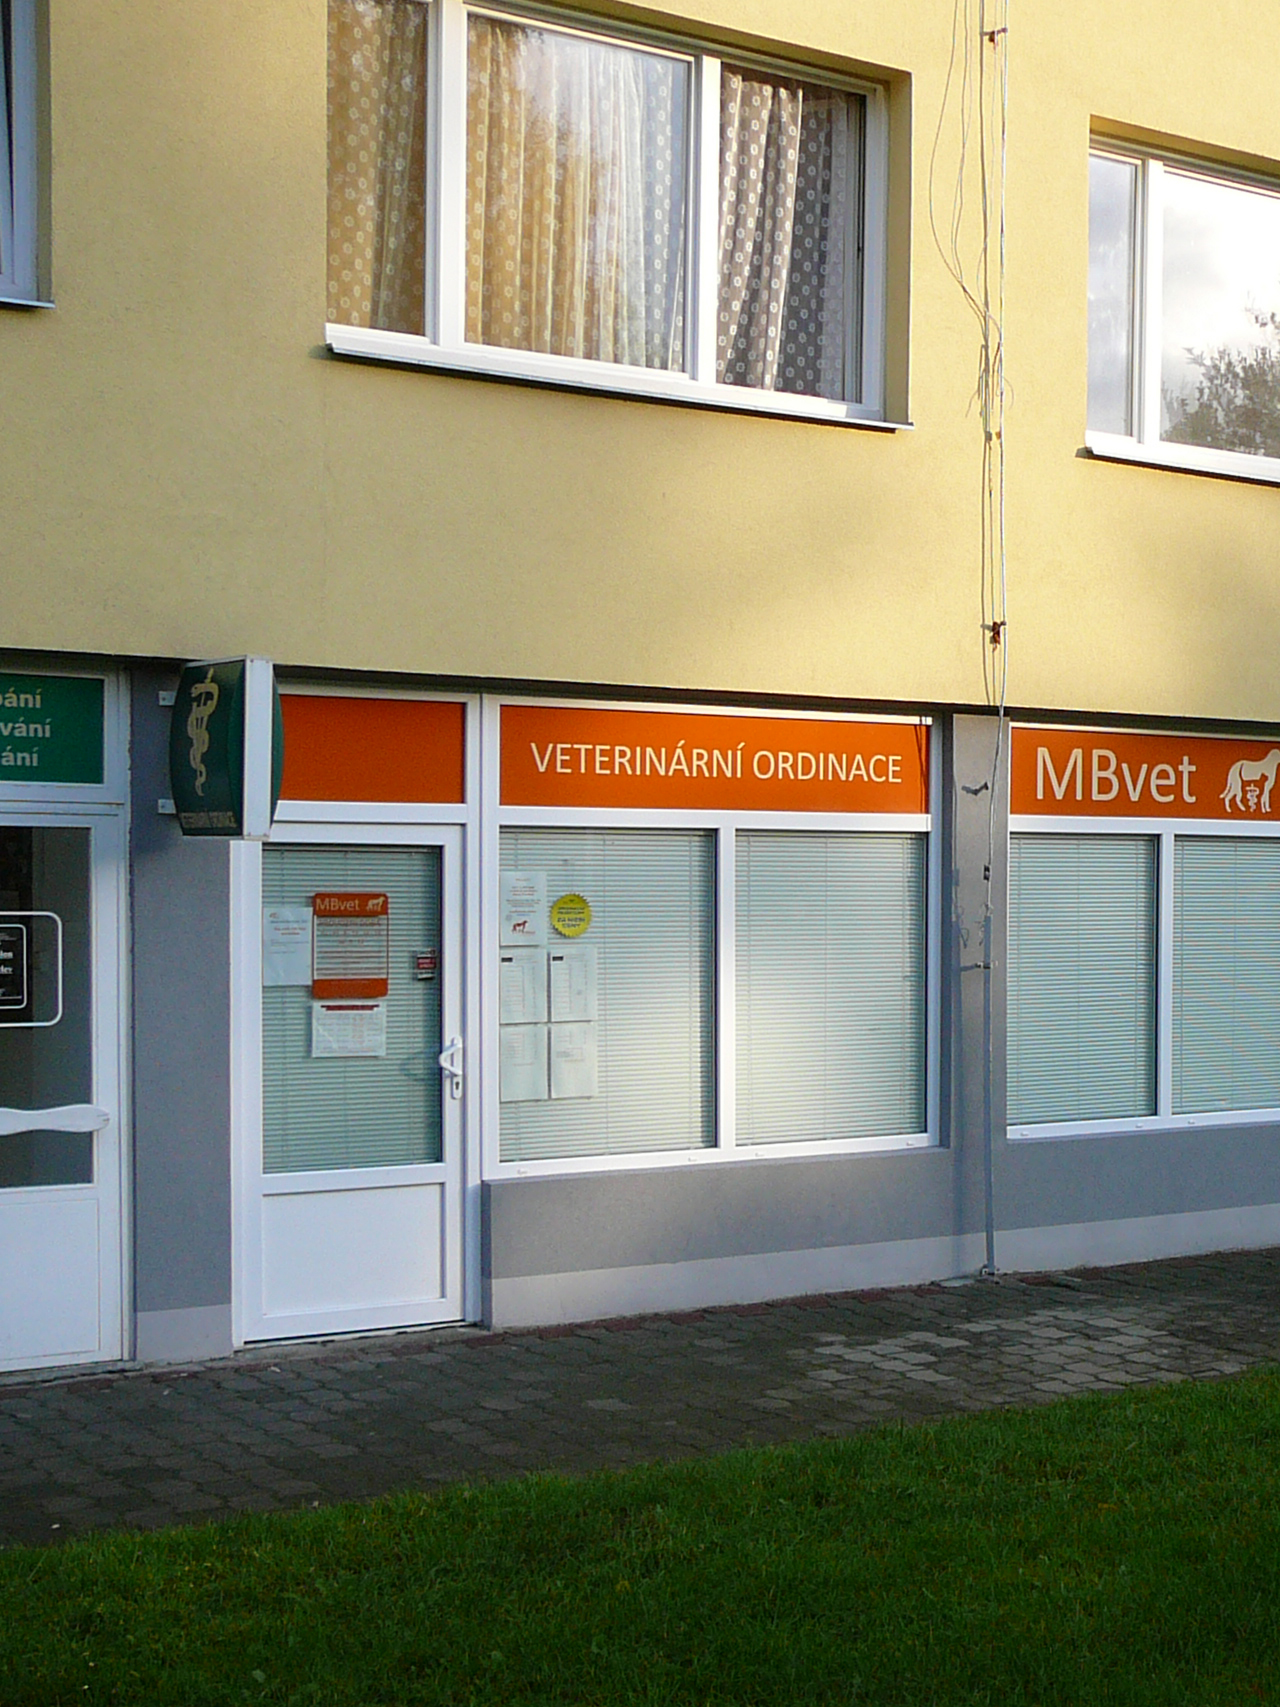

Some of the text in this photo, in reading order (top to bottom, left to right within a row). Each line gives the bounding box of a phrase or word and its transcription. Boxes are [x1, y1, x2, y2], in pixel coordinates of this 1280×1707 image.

[0, 687, 42, 708] ání
[530, 740, 902, 783] VETERINÁRNÍ ORDINACE
[1036, 746, 1197, 803] MBvet
[315, 897, 360, 911] MBvet
